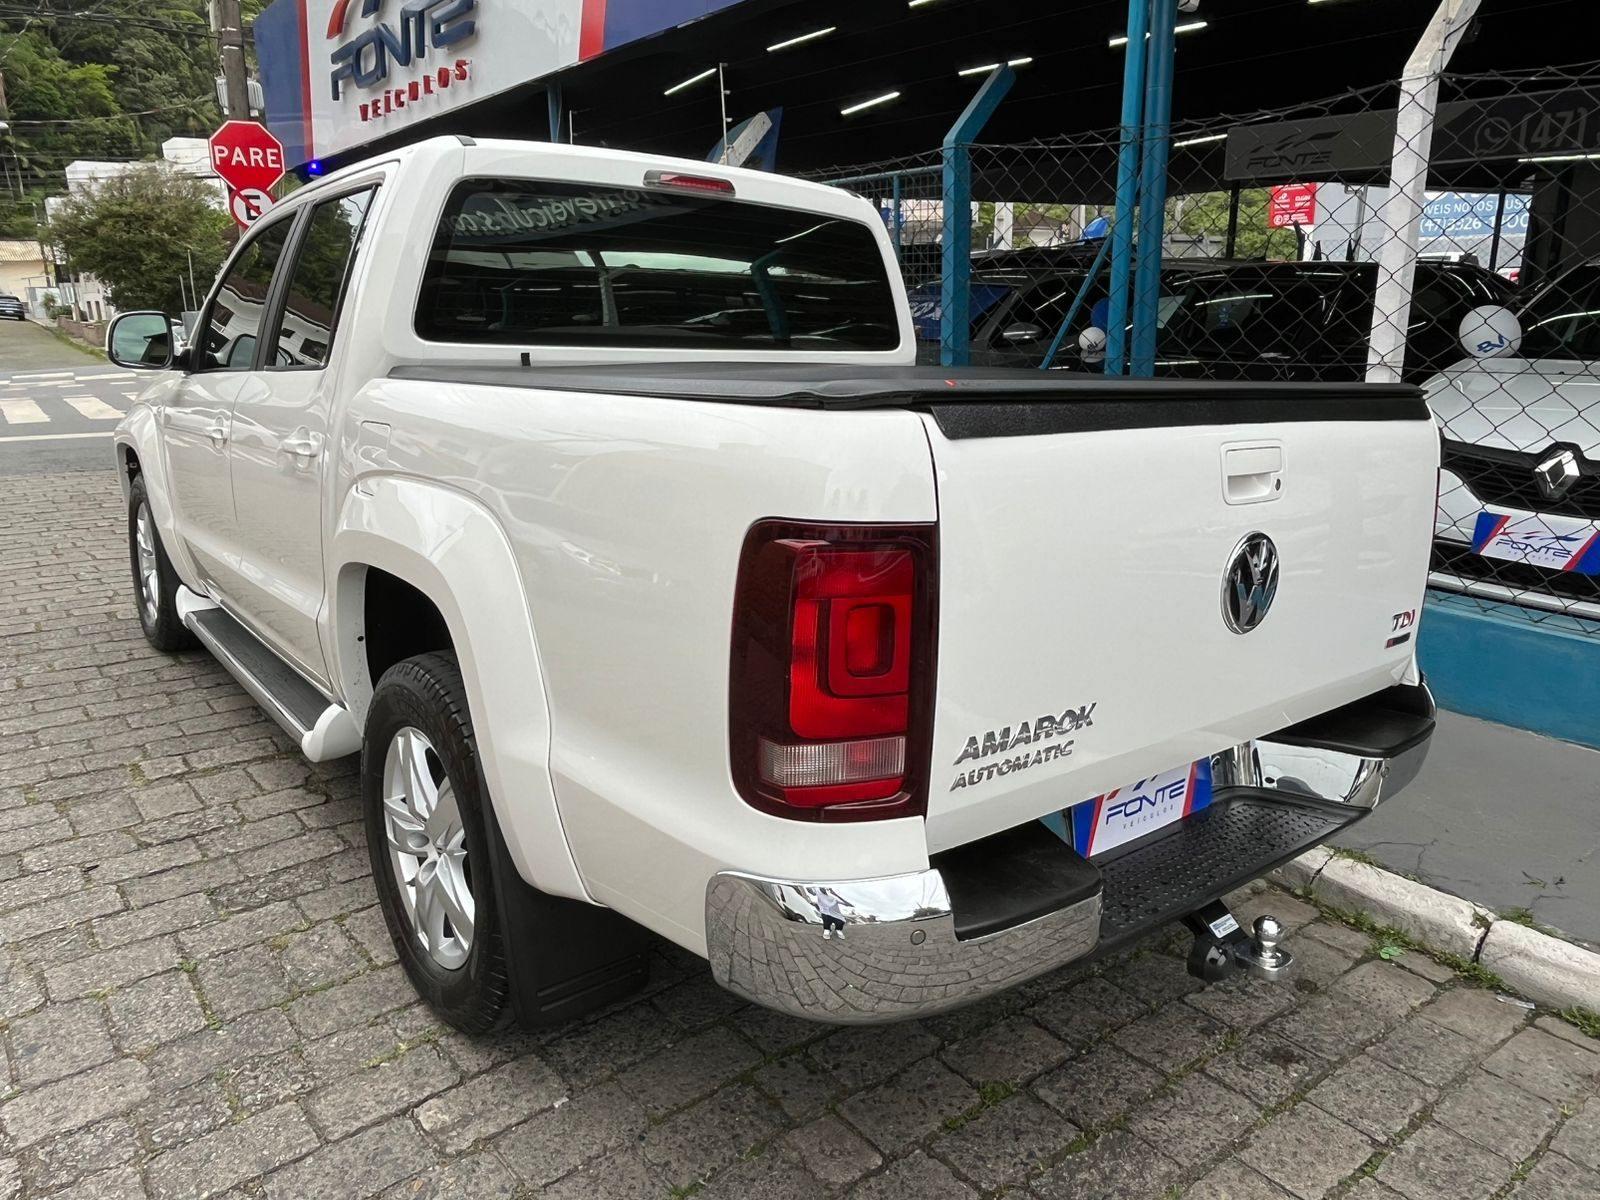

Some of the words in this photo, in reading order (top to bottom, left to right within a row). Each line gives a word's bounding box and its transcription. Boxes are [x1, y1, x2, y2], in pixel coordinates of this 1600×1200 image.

[330, 0, 476, 101] FONTE
[213, 144, 282, 169] PARE
[1495, 538, 1573, 558] FONTE
[1391, 609, 1416, 632] TDI
[953, 702, 1097, 766] AMAROK
[950, 740, 1075, 792] AUTOMATIC
[1105, 778, 1187, 826] FONTE
